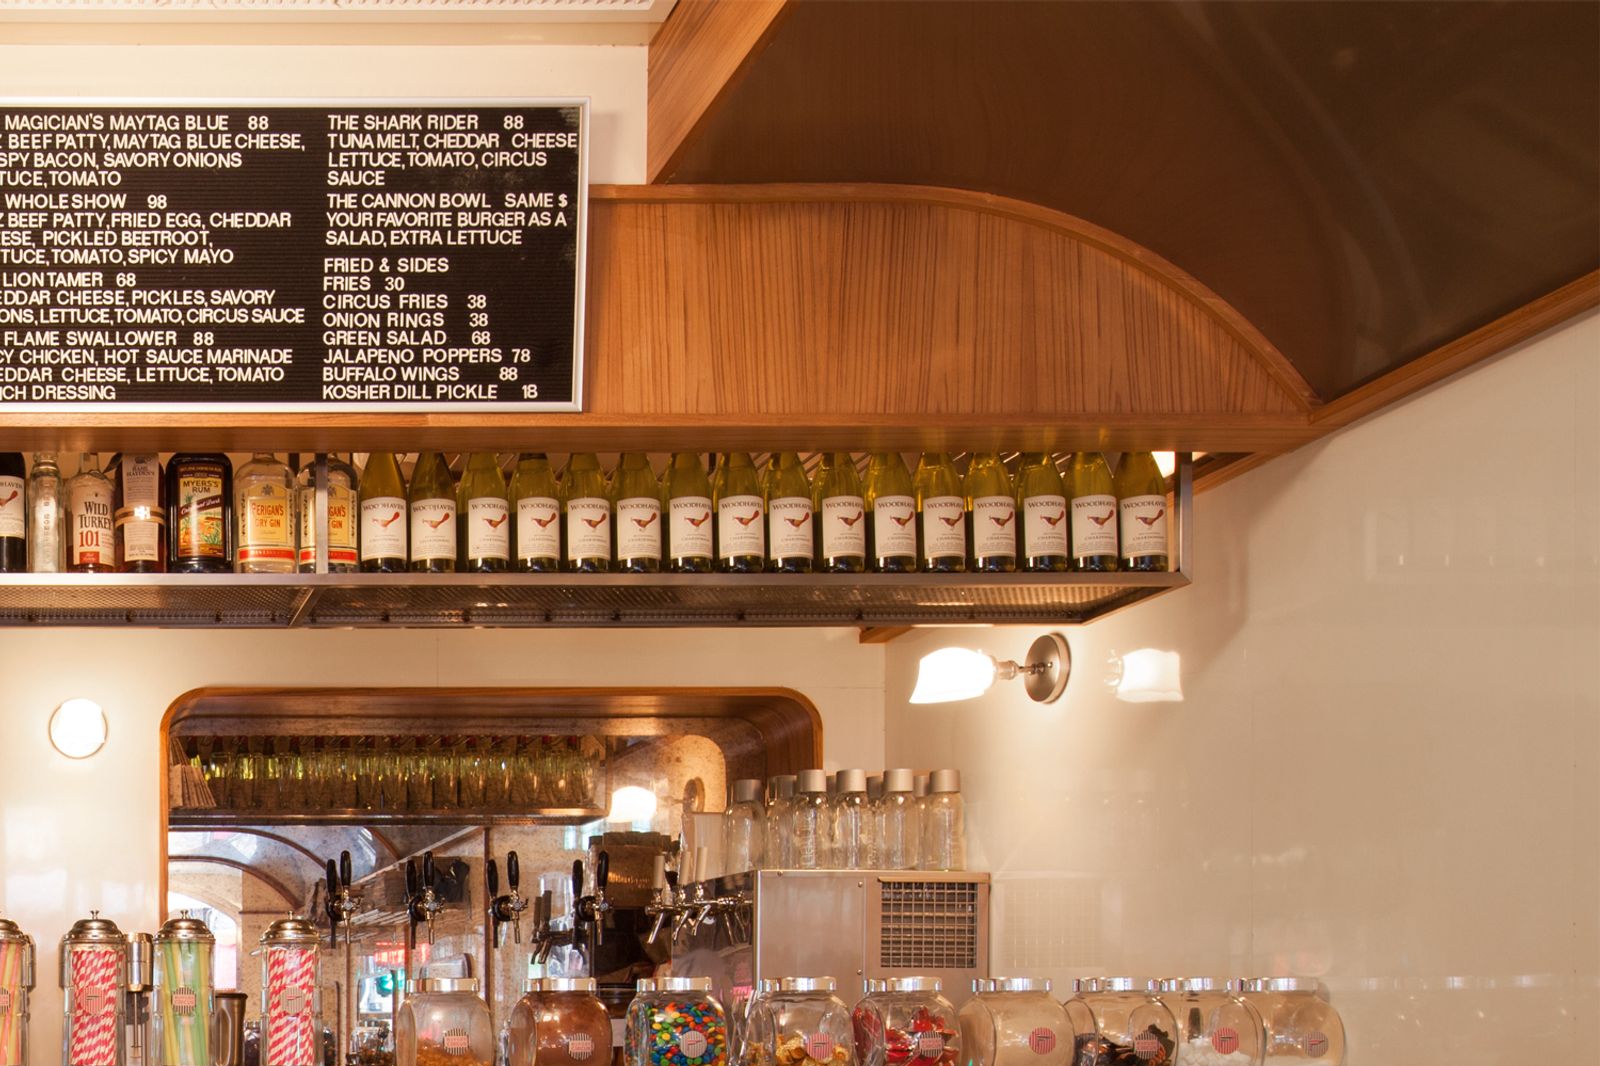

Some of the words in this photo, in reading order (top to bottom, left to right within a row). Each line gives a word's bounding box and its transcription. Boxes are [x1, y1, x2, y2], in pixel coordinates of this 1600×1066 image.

[5, 114, 104, 130] MAGICIAN'S
[110, 114, 179, 131] MAYTAG
[185, 115, 228, 131] BLUE
[248, 116, 268, 130] 88
[328, 115, 359, 130] THE
[364, 114, 422, 130] SHARK
[428, 115, 478, 130] RIDER
[504, 115, 523, 129] 88
[9, 133, 52, 149] BEEF
[114, 134, 181, 149] MAYTAG
[187, 134, 232, 150] BLUE
[328, 133, 374, 148] TUNA
[424, 133, 499, 148] CHEDDAR
[512, 133, 577, 148] CHEESE
[104, 152, 170, 167] SAVORY
[173, 152, 242, 168] ONIONS
[482, 152, 547, 167] CIRCUS
[327, 171, 385, 185] SAUCE
[5, 194, 69, 209] WHOLE
[71, 194, 126, 209] SHOW
[147, 195, 167, 209] 98
[327, 194, 357, 208] THE
[362, 193, 435, 208] CANNON
[440, 193, 491, 208] BOWL
[505, 193, 553, 208] SAME
[559, 194, 567, 207] $
[8, 213, 48, 228] BEEF
[210, 212, 291, 228] CHEDDAR
[327, 212, 373, 227] YOUR
[377, 212, 452, 227] FAVORITE
[458, 212, 525, 227] BURGER
[528, 212, 551, 226] AS
[555, 212, 567, 226] A
[43, 231, 117, 246] PICKLED
[391, 230, 442, 245] EXTRA
[447, 230, 522, 244] LETTUCE
[325, 258, 373, 273] FRIED
[379, 258, 389, 272] &
[397, 258, 449, 272] SIDES
[3, 272, 44, 287] LION
[47, 272, 103, 287] TAMER
[116, 273, 136, 287] 68
[324, 276, 371, 291] FRIES
[385, 277, 404, 291] 30
[323, 294, 390, 309] CIRCUS
[400, 294, 448, 308] FRIES
[468, 295, 486, 309] 38
[323, 313, 380, 328] ONION
[388, 312, 444, 328] RINGS
[470, 313, 488, 327] 38
[5, 331, 59, 346] FLAME
[66, 330, 177, 346] SWALLOWER
[193, 332, 214, 345] 88
[323, 331, 380, 346] GREEN
[387, 330, 446, 345] SALAD
[472, 331, 490, 345] 68
[105, 349, 139, 364] HOT
[146, 349, 202, 364] SAUCE
[207, 348, 292, 364] MARINADE
[324, 349, 414, 364] JALAPENO
[423, 348, 502, 363] POPPERS
[512, 349, 530, 363] 78
[216, 367, 284, 382] TOMATO
[323, 367, 396, 381] BUFFALO
[401, 366, 459, 381] WINGS
[499, 367, 517, 381] 88
[32, 385, 115, 400] DRESSING
[323, 385, 390, 399] KOSHER
[395, 384, 431, 399] DILL
[437, 385, 497, 399] PICKLE
[522, 384, 537, 398] 18
[192, 486, 210, 494] RUM
[84, 501, 108, 516] WILD
[79, 514, 112, 530] TURKEY
[269, 519, 281, 529] GIN
[79, 530, 100, 547] 101
